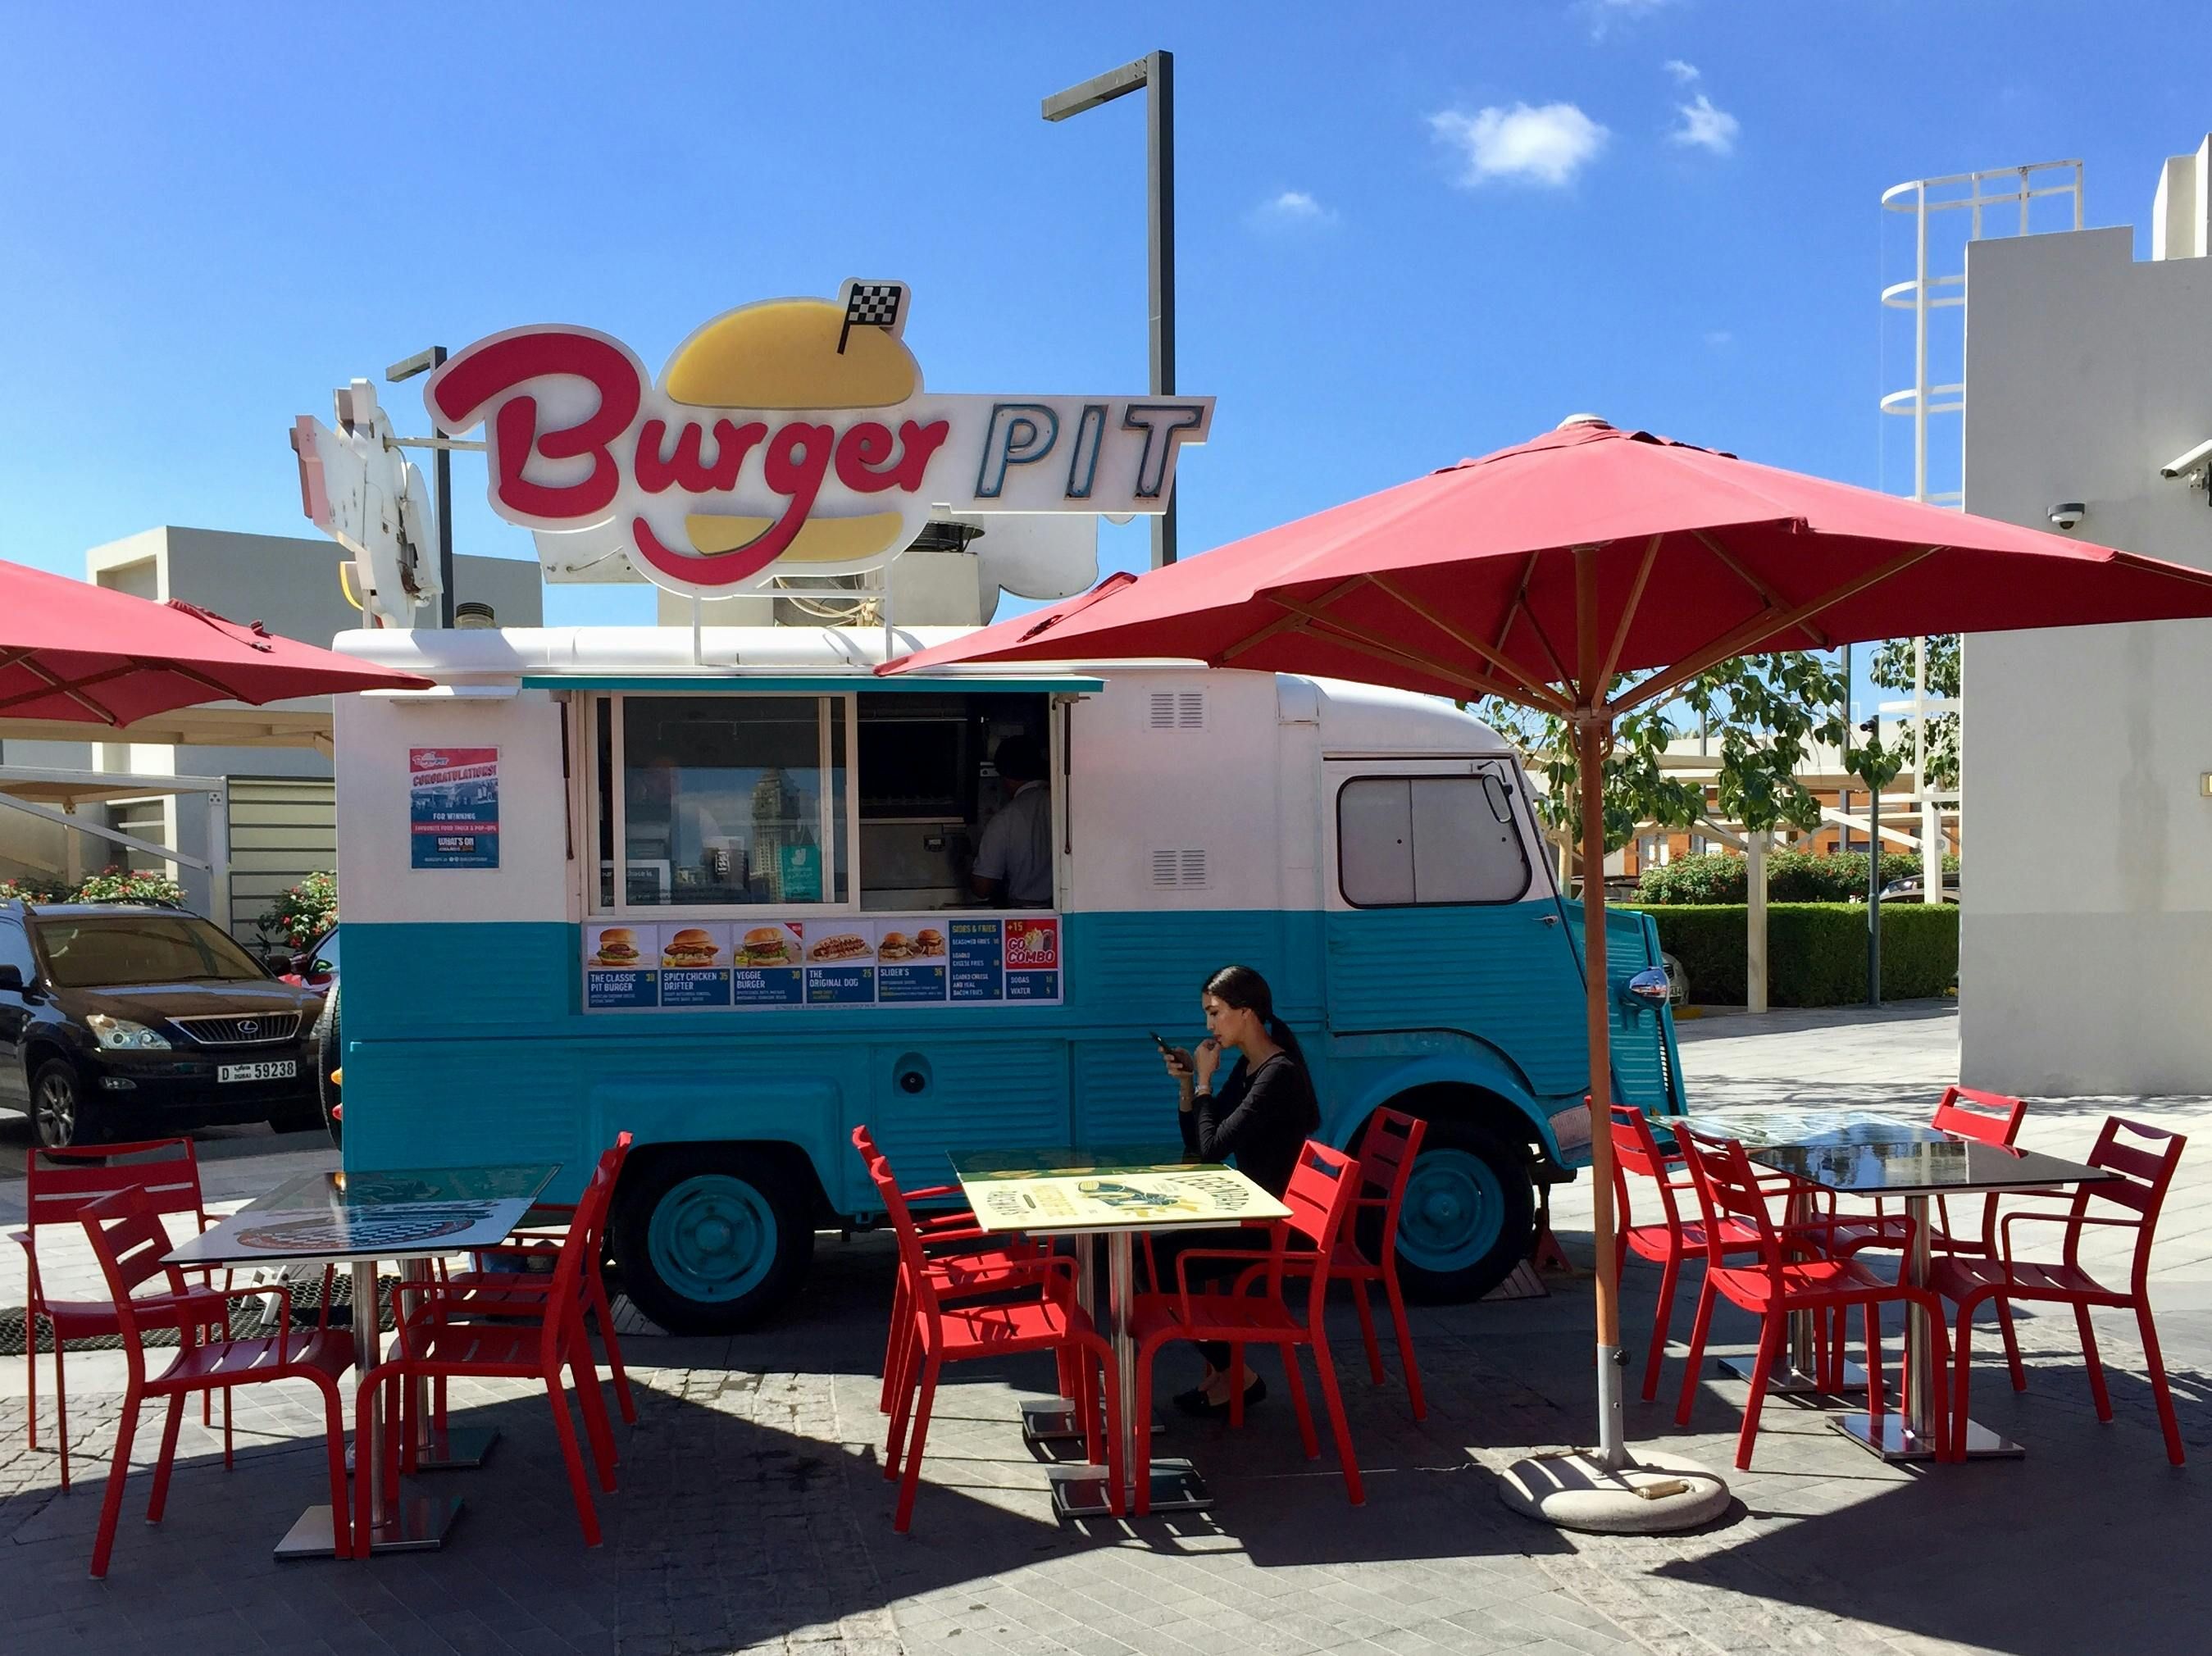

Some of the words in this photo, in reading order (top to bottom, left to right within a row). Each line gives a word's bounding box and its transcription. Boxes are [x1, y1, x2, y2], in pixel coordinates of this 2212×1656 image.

[434, 331, 950, 585] Burger
[975, 403, 1205, 500] PIT
[413, 765, 497, 786] CONGRATULATIONS!
[438, 837, 464, 846] WHAT'S
[464, 837, 474, 846] ON
[952, 925, 972, 933] SIDES
[972, 925, 976, 933] &
[978, 924, 997, 933] FRIES
[1008, 921, 1023, 931] +15
[1008, 938, 1025, 951] GO
[1008, 950, 1055, 963] COMBO
[590, 974, 604, 982] THE
[605, 973, 636, 981] CLASSIC
[663, 972, 685, 981] SPICY
[685, 971, 717, 981] CHICKEN
[719, 971, 728, 980] 35
[736, 971, 762, 980] VEGGIE
[791, 971, 800, 980] 30
[809, 970, 822, 978] THE
[862, 969, 872, 978] 25
[590, 983, 602, 992] PIT
[604, 983, 633, 991] BURGER
[664, 982, 694, 990] DRIFTER
[736, 980, 766, 989] BURGER
[809, 979, 842, 988] ORIGINAL
[844, 978, 858, 987] DOG
[222, 1067, 229, 1080] D
[255, 1062, 294, 1078] 59238
[1164, 1173, 1249, 1211] LEGENDARY
